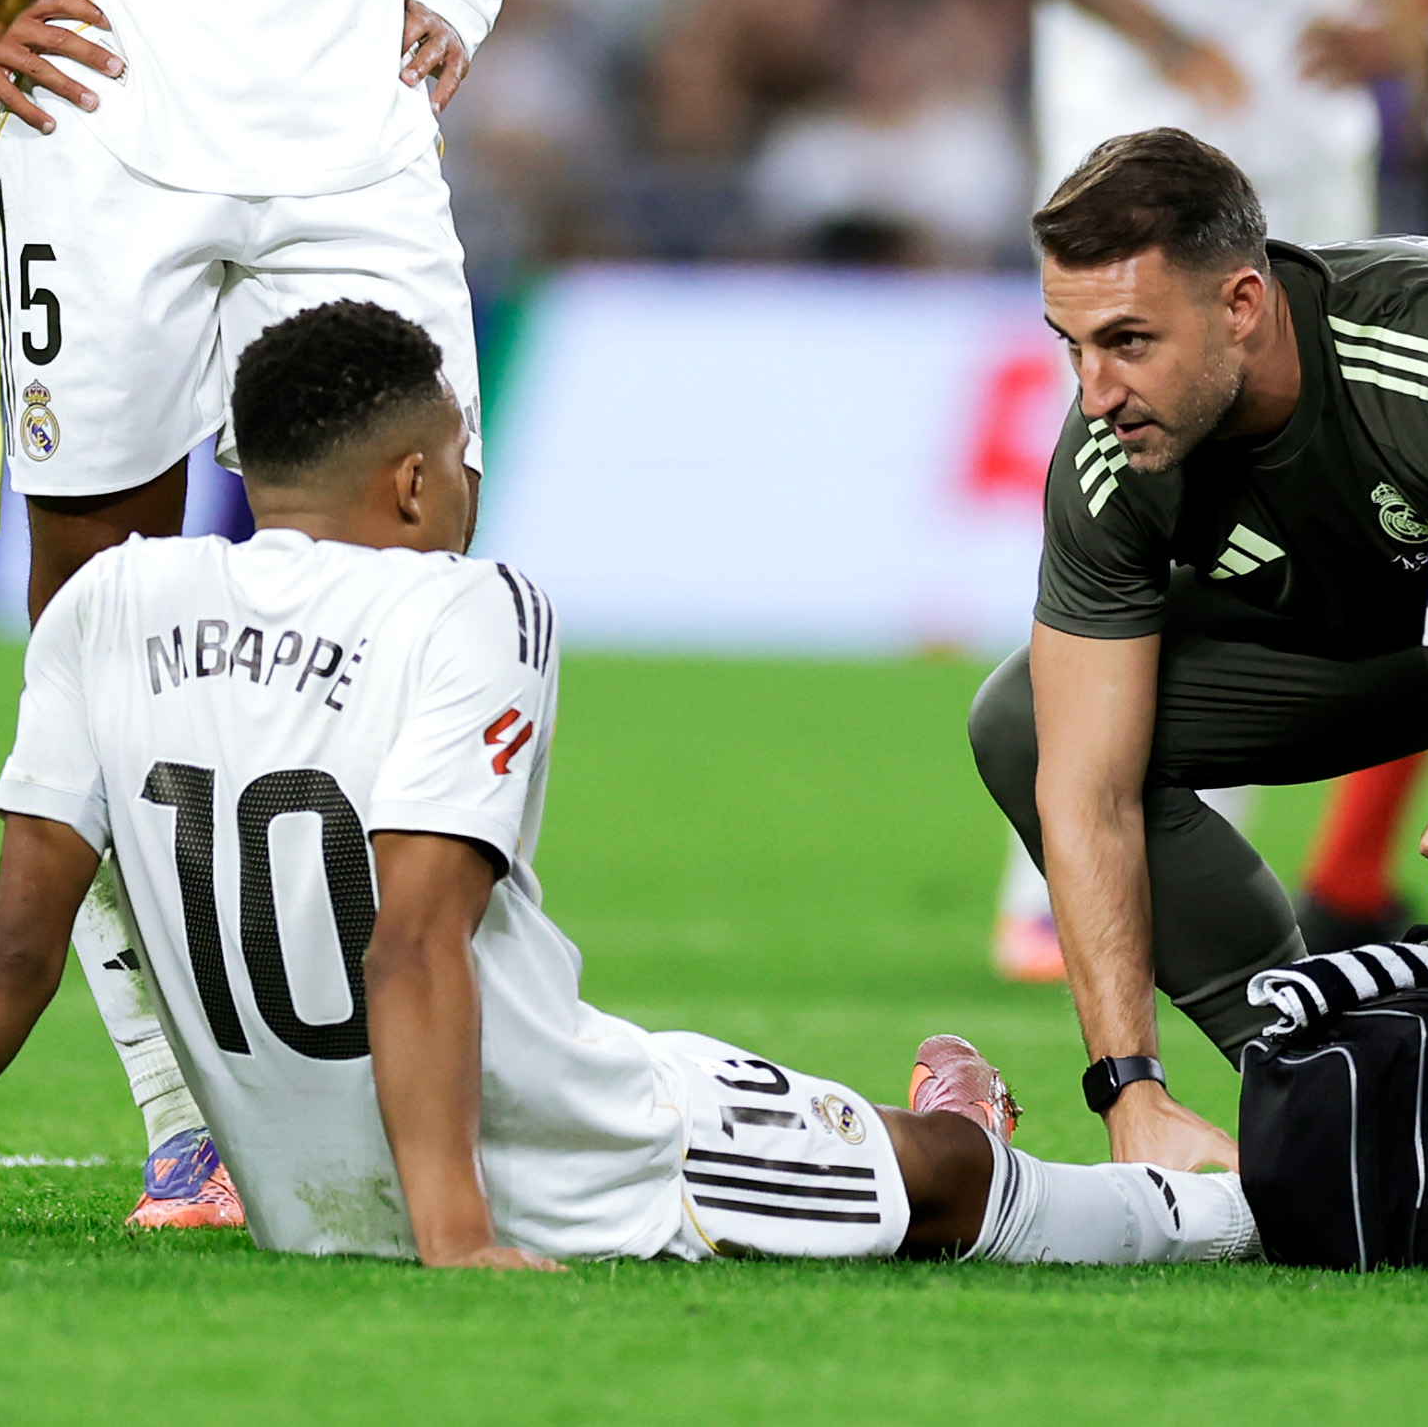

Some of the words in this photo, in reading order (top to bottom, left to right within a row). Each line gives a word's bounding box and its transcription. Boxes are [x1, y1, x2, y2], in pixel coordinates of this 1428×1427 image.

[20, 243, 62, 366] 5
[146, 619, 369, 713] MBAPPÉ
[140, 761, 379, 1061] 10
